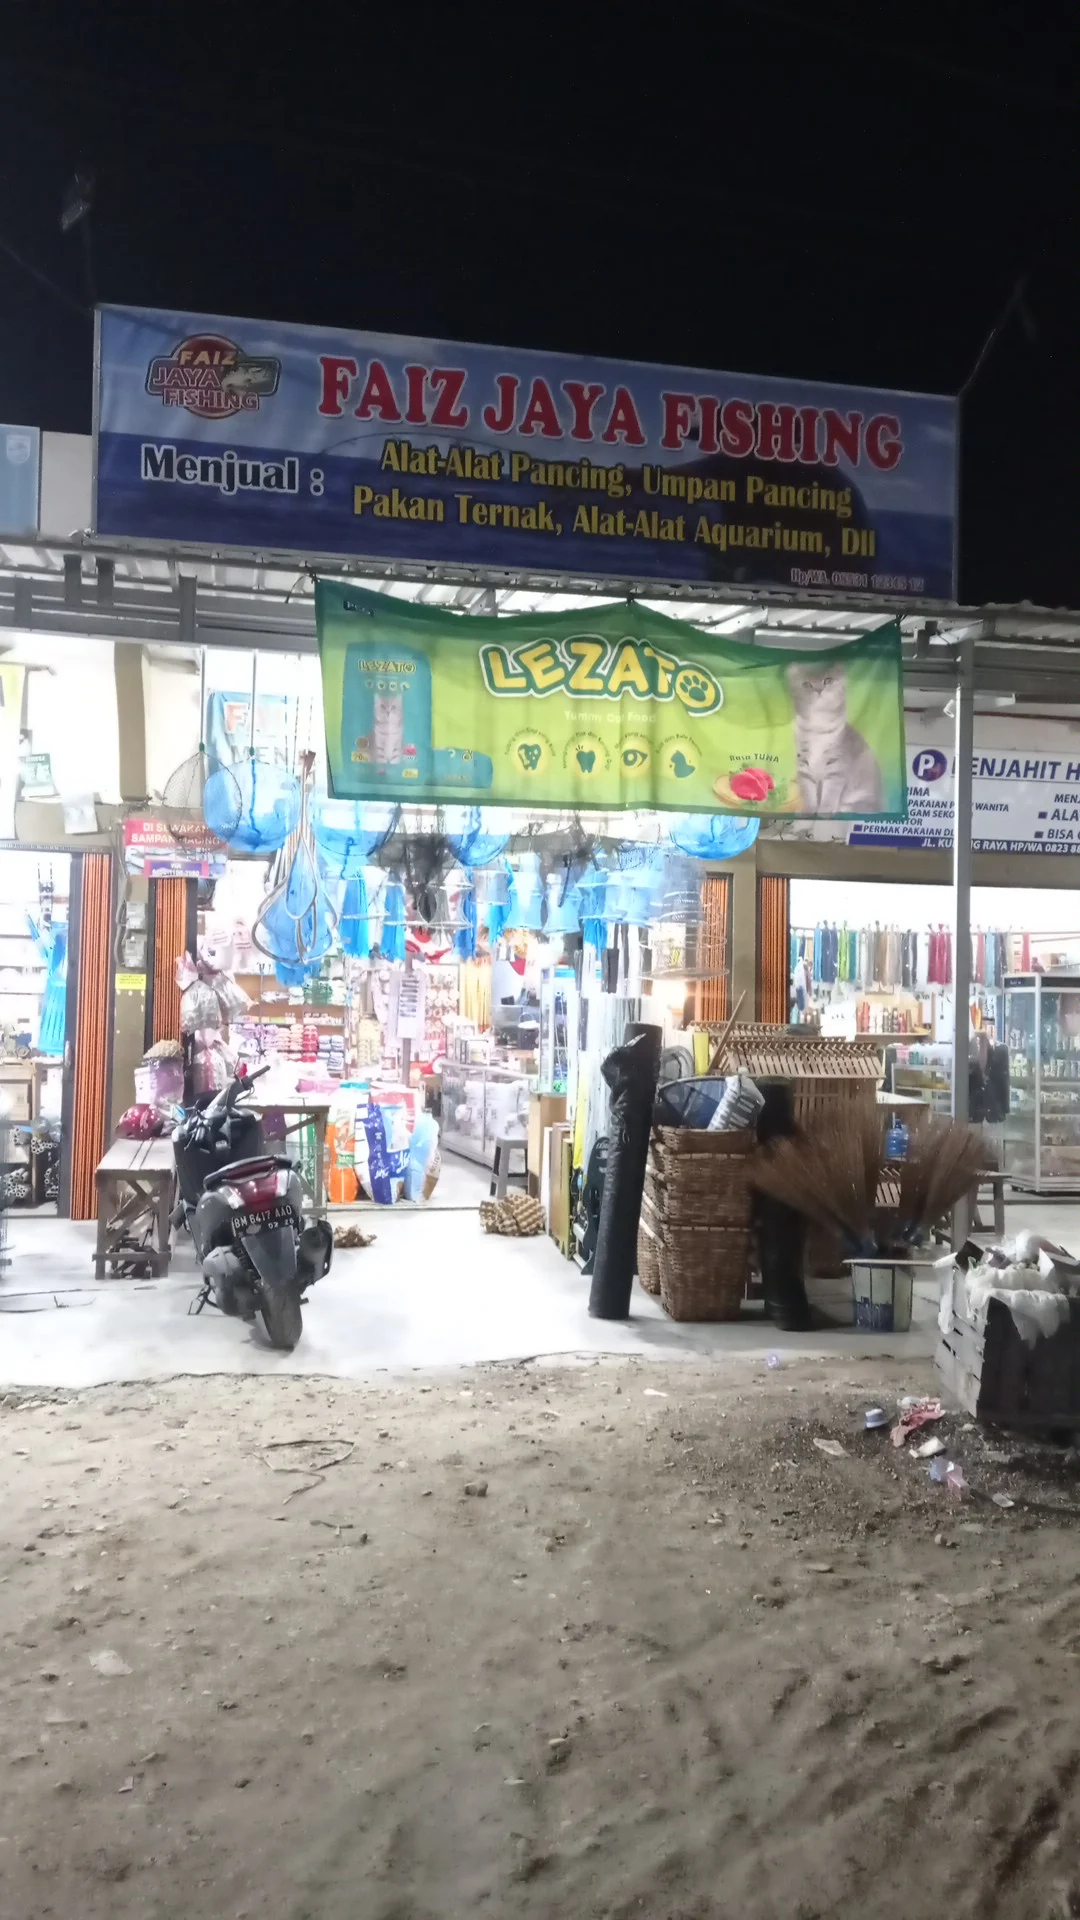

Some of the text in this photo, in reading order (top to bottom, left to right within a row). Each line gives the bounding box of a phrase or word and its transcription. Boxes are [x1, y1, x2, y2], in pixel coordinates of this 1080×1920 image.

[178, 349, 239, 366] FAIZ
[152, 367, 220, 388] JAYA
[162, 388, 260, 411] FISHING
[318, 355, 904, 472] FAIZ JAYA FISHING
[140, 443, 299, 496] Menjual
[380, 440, 852, 519] Alat-Alat Pancing, Umpan Pancing
[353, 485, 445, 523] Pakan
[453, 493, 563, 537] Ternak,
[572, 504, 686, 542] Alat-Alat
[693, 515, 832, 559] Aquarium,
[479, 634, 724, 717] LEZATO
[753, 753, 780, 763] TUNA
[952, 756, 1062, 780] ENJAHIT
[908, 799, 948, 809] PAKAIAN
[975, 802, 1010, 813] WANITA
[1050, 808, 1080, 821] ALA
[863, 825, 900, 835] PERMAK
[902, 827, 941, 836] PAKAIAN
[1047, 829, 1074, 840] BISA
[982, 841, 1008, 851] RAYA
[1010, 842, 1043, 852] HP/WA
[1045, 844, 1069, 854] 0823
